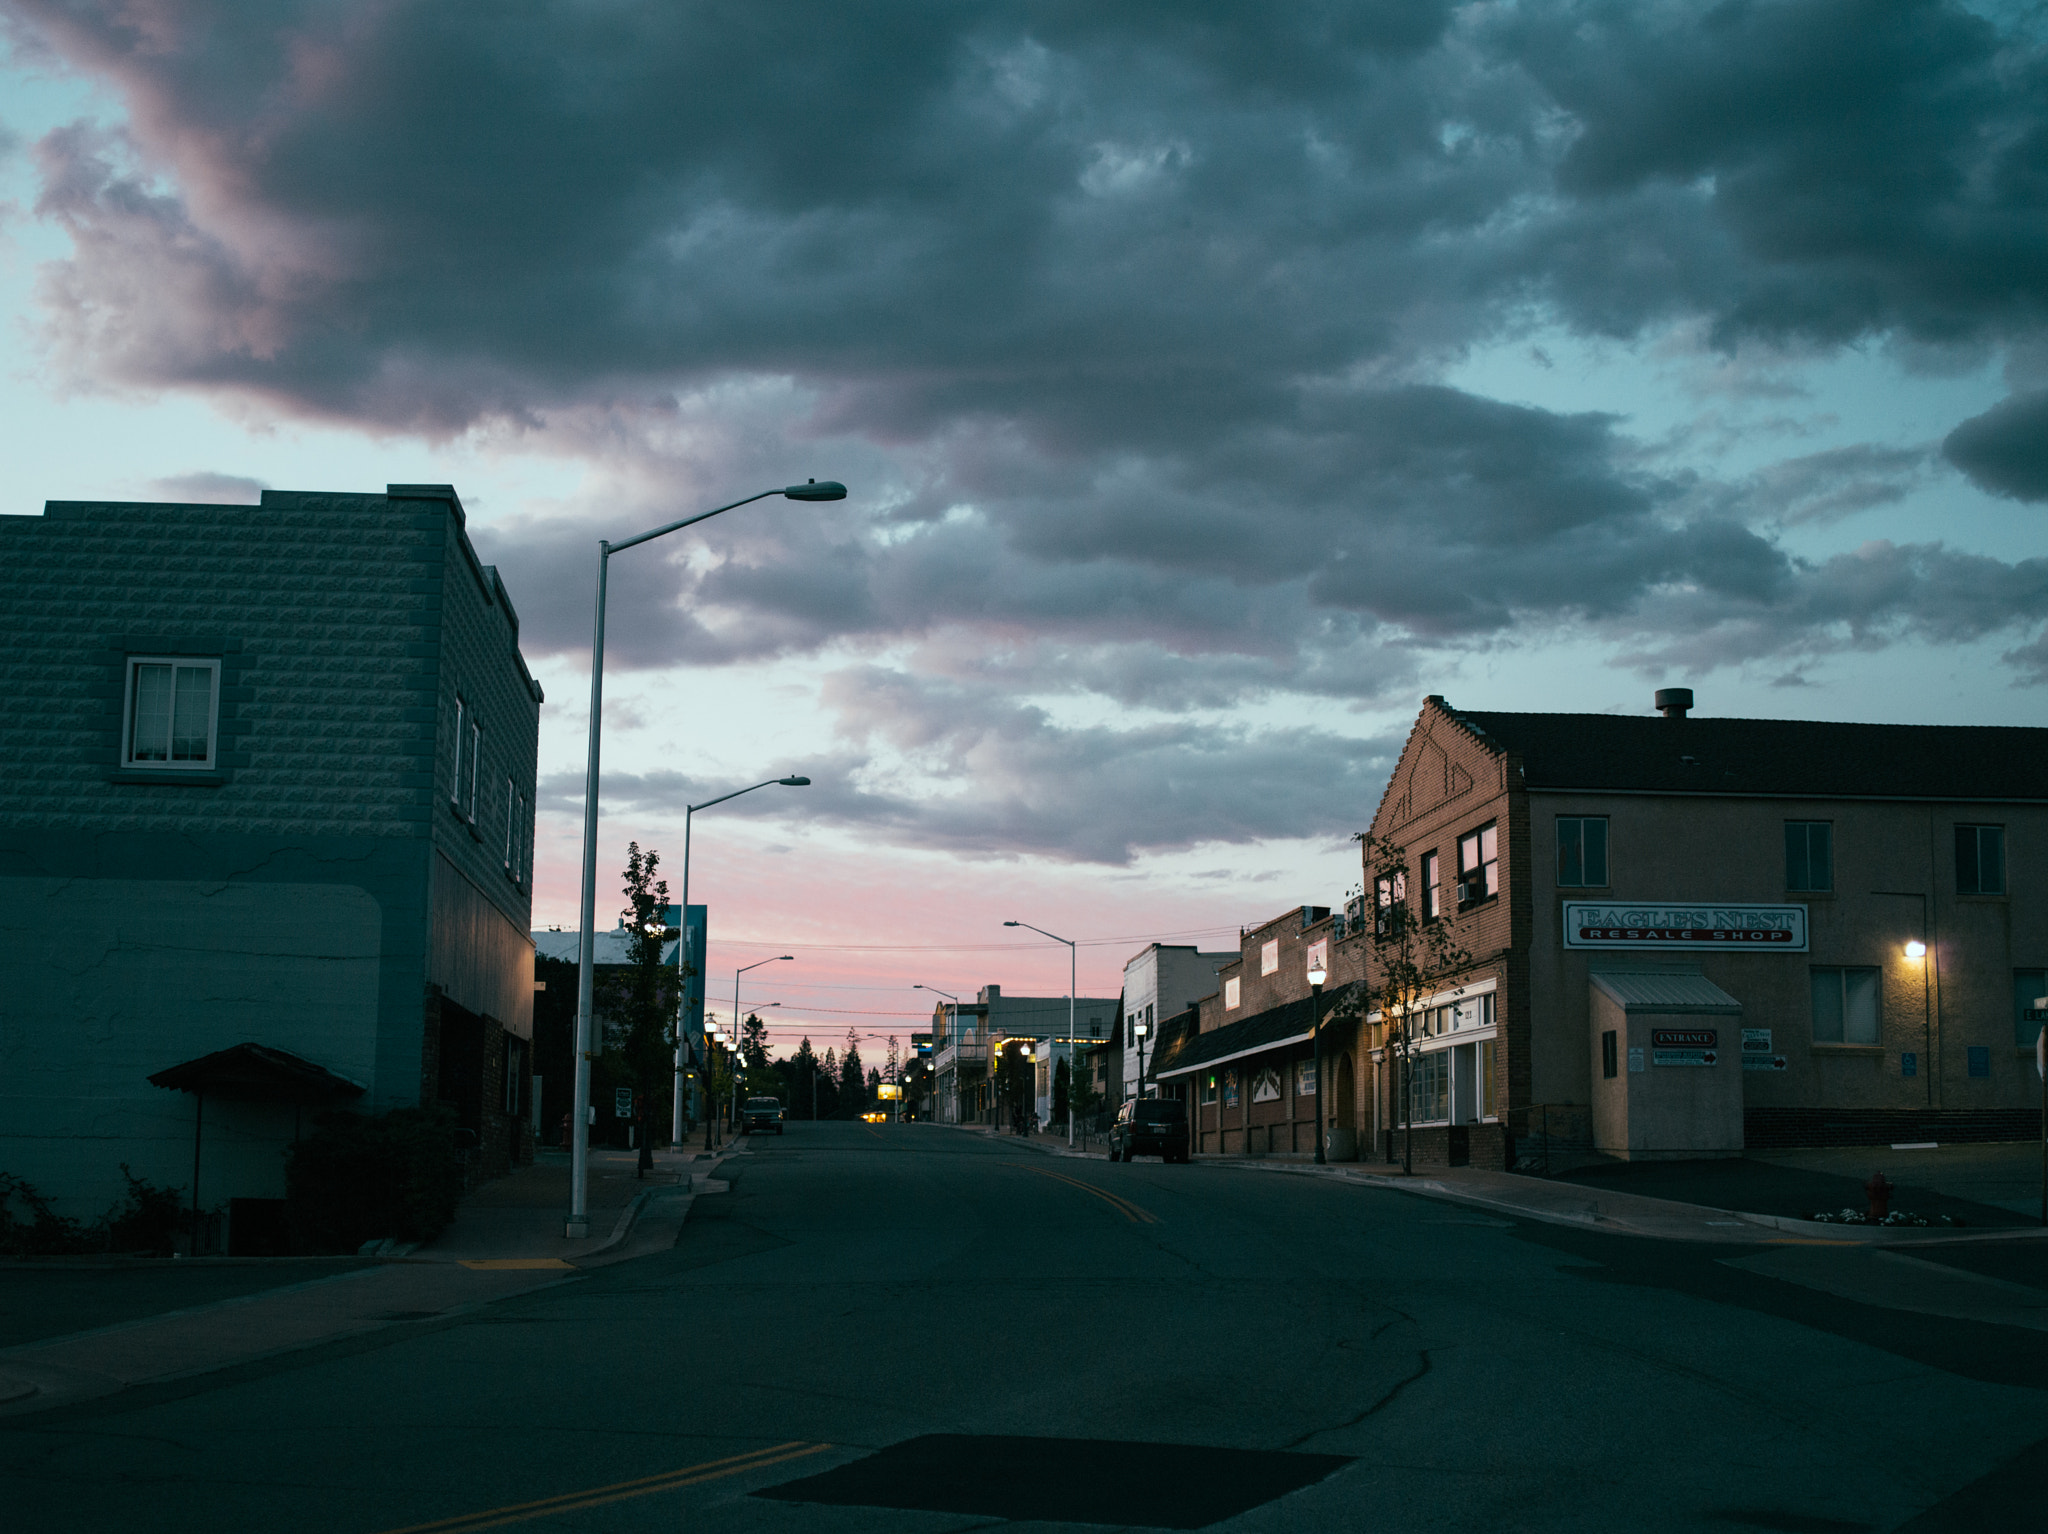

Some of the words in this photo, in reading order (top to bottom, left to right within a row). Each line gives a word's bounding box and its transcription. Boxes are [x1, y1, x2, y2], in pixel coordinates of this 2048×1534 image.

[1577, 909, 1708, 929] EAGLE'S
[1713, 911, 1796, 930] NEST
[1589, 930, 1694, 940] RESALE
[1713, 931, 1784, 941] SHOP
[2035, 1010, 2048, 1020] LA
[1659, 1033, 1709, 1042] ENTRANCE
